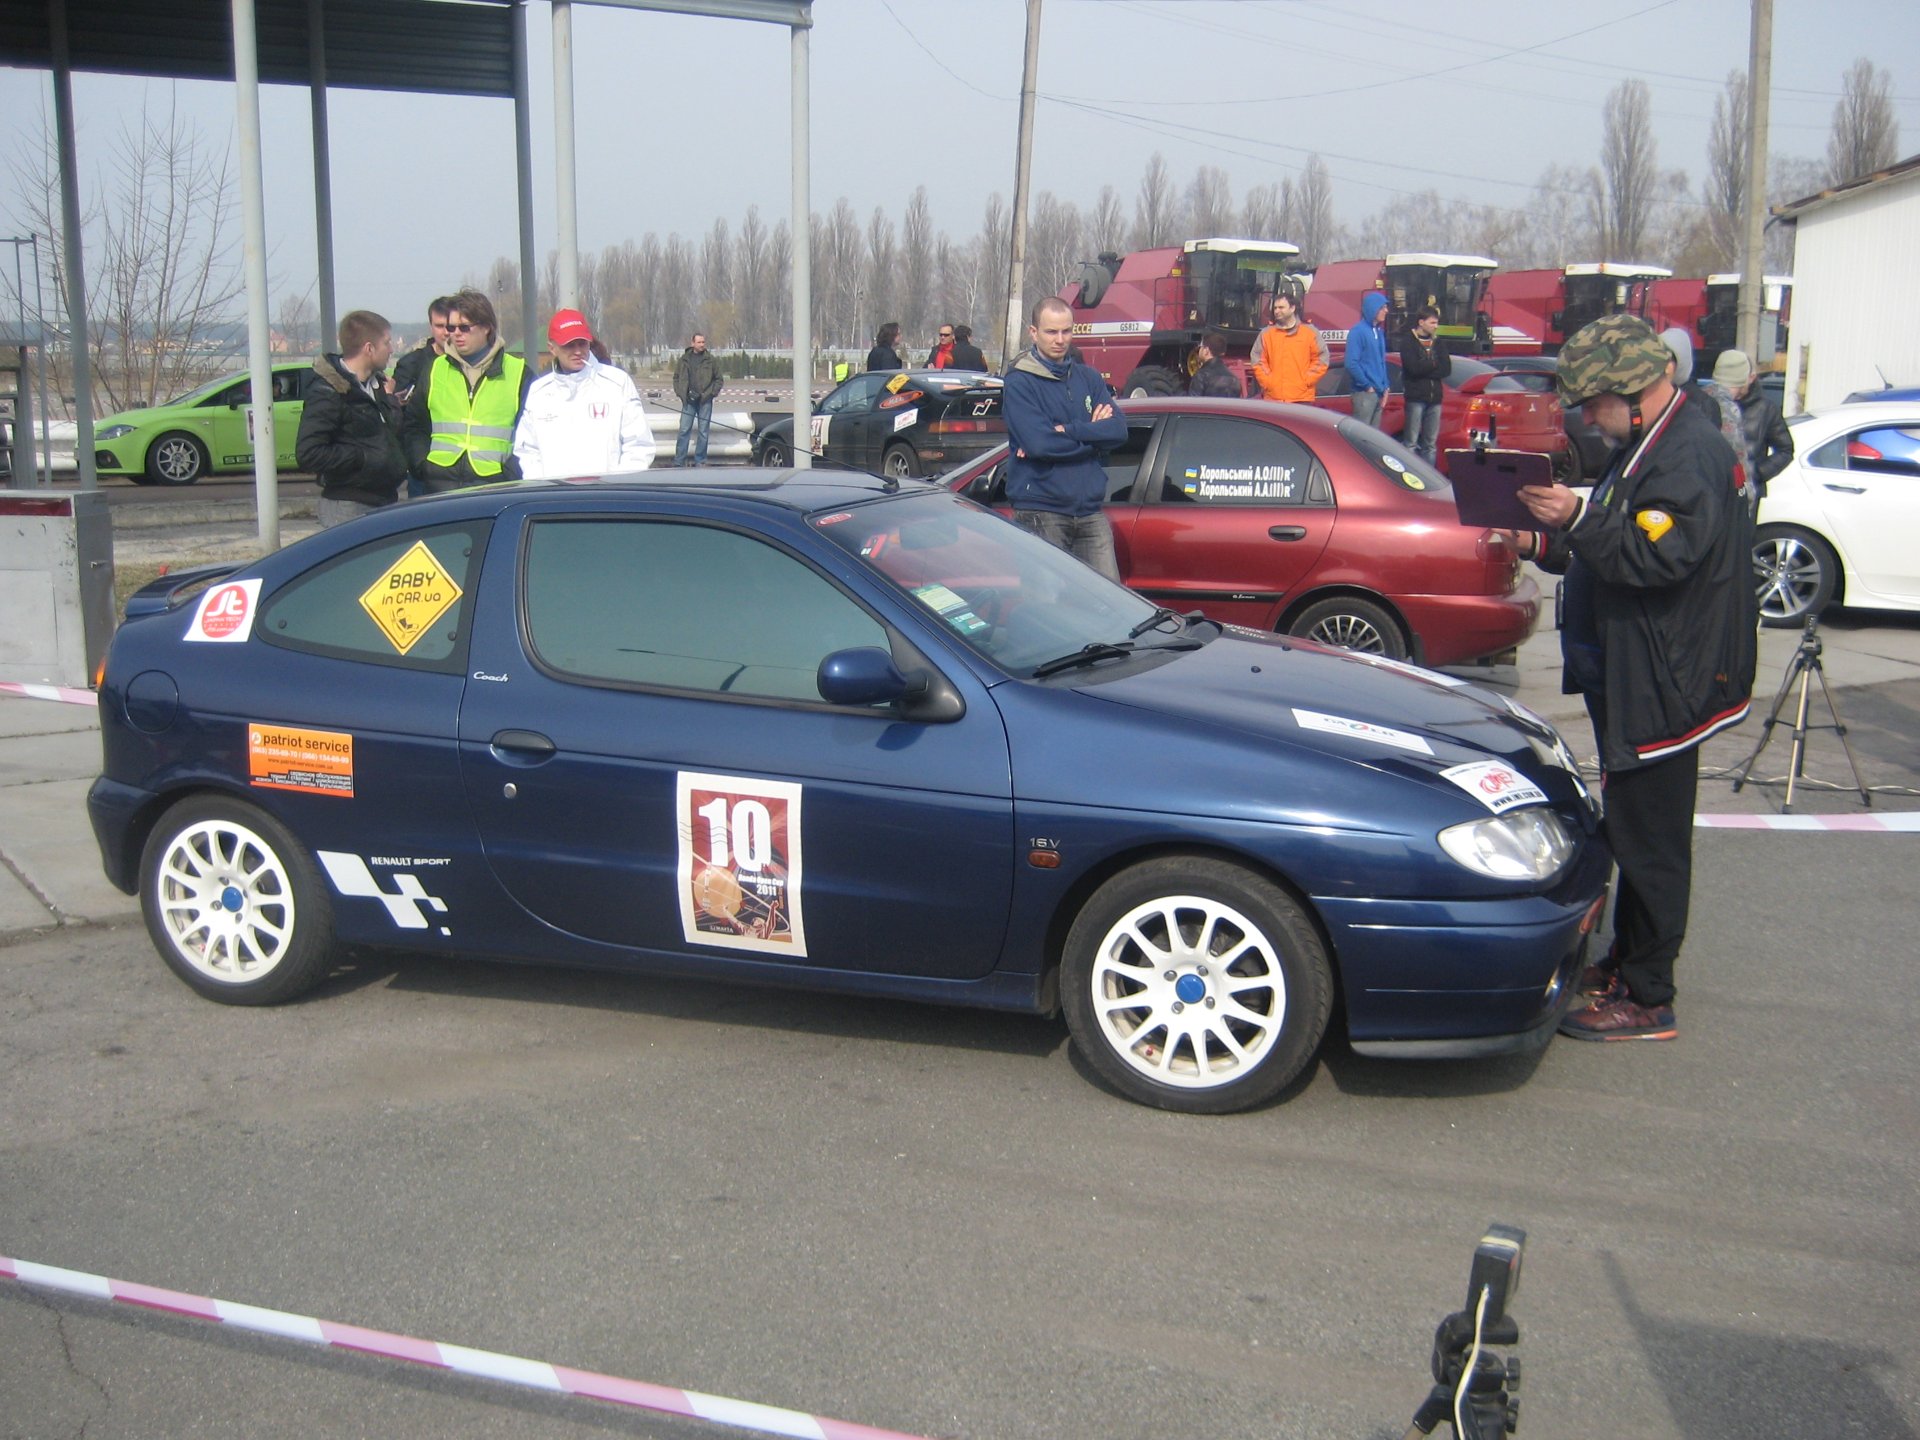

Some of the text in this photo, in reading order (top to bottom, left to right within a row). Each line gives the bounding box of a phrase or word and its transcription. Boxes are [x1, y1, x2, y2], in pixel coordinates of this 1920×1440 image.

[1199, 465, 1253, 484] Хорольський
[1199, 481, 1253, 500] Хорольський
[389, 571, 436, 589] BABY
[381, 591, 441, 606] in CAR.ua
[473, 671, 509, 682] Coach
[263, 734, 350, 753] patriot service
[698, 797, 772, 872] 10
[371, 856, 412, 866] RENAULT
[756, 884, 777, 896] 2011
